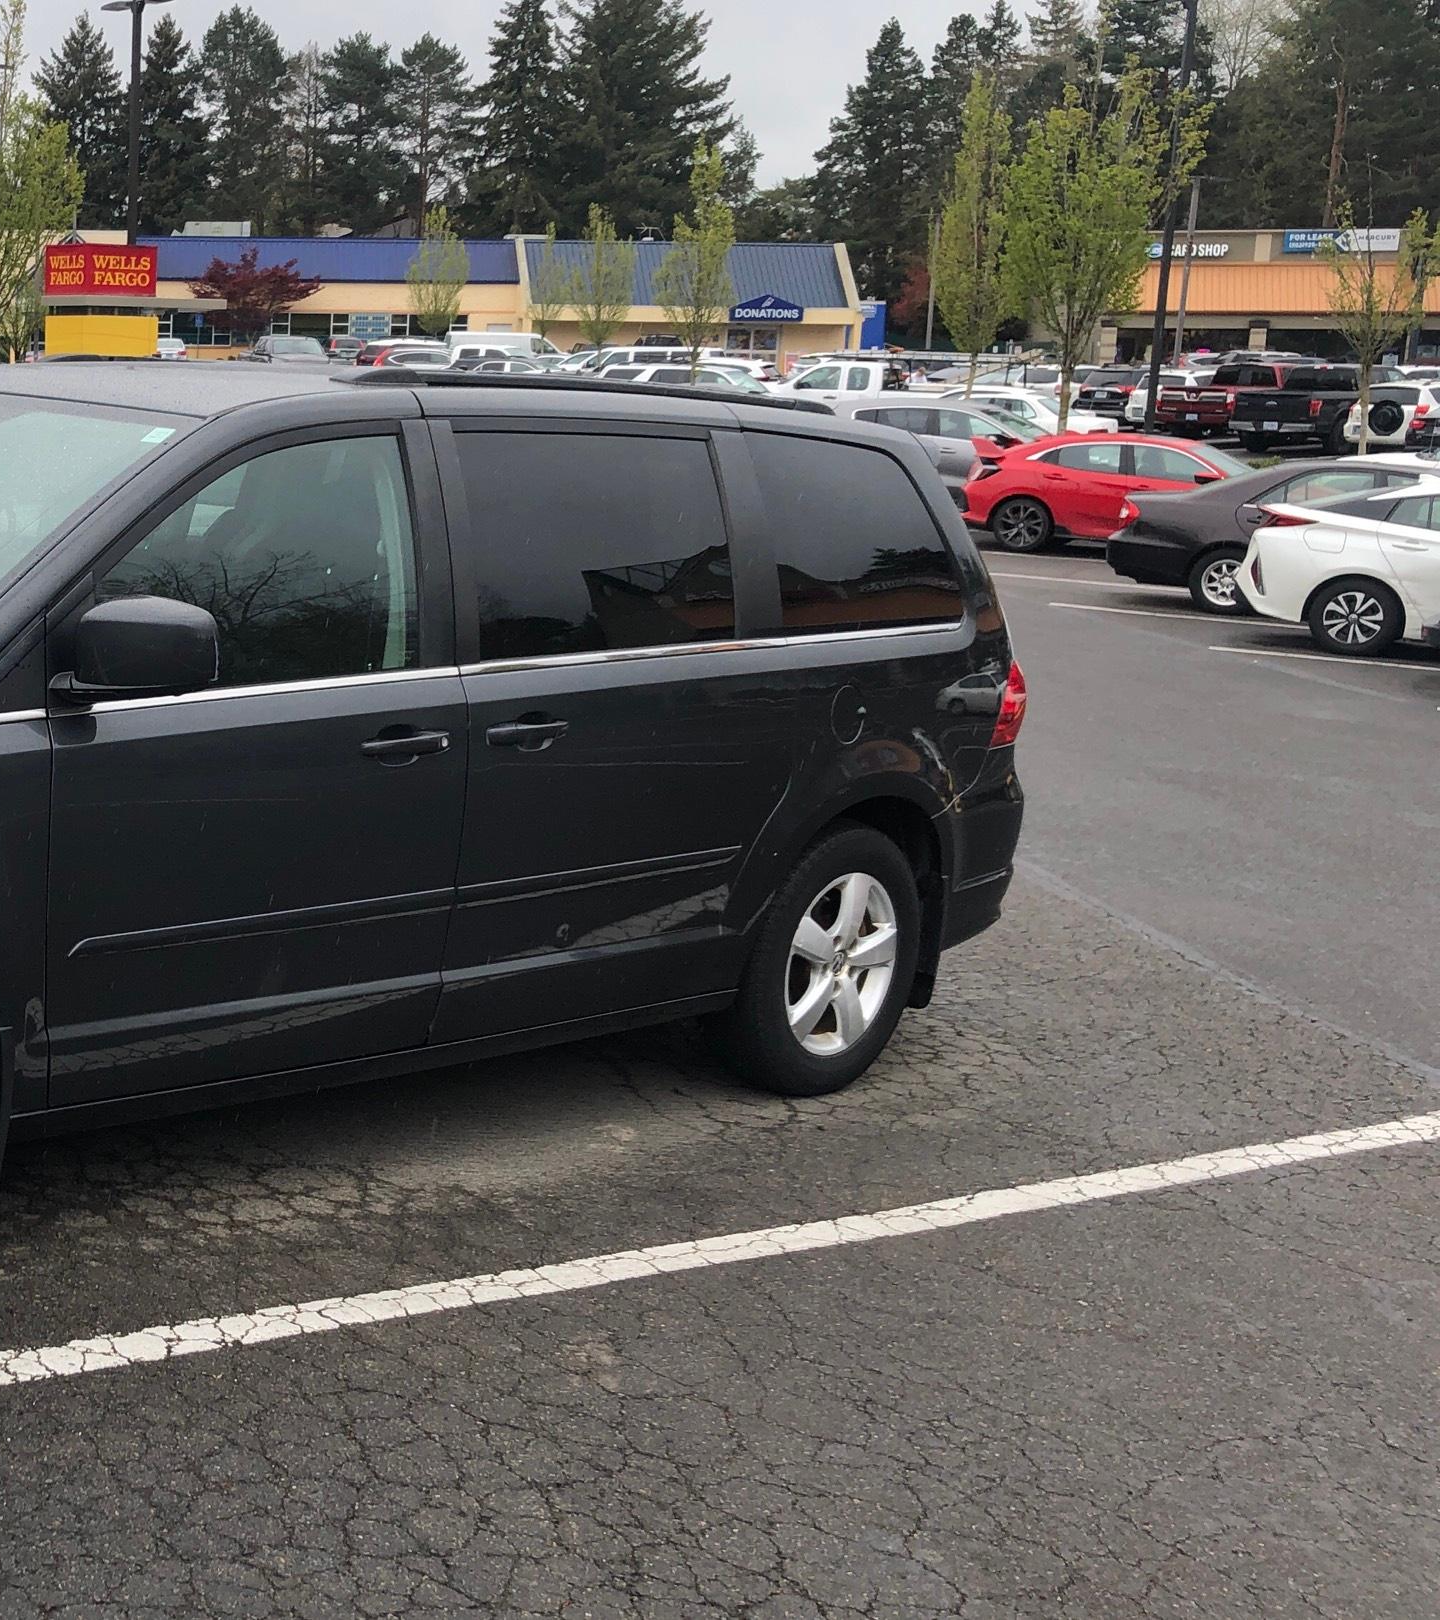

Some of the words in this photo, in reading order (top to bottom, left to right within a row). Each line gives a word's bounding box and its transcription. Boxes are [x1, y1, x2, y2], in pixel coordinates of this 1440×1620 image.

[1289, 233, 1306, 242] FOR
[1307, 233, 1334, 242] LEASE
[1198, 243, 1229, 257] SHOP
[49, 255, 85, 269] WELLS
[92, 255, 151, 271] WELLS
[49, 271, 85, 286] FARGO
[93, 271, 151, 287] FARGO
[734, 308, 800, 319] DONATIONS
